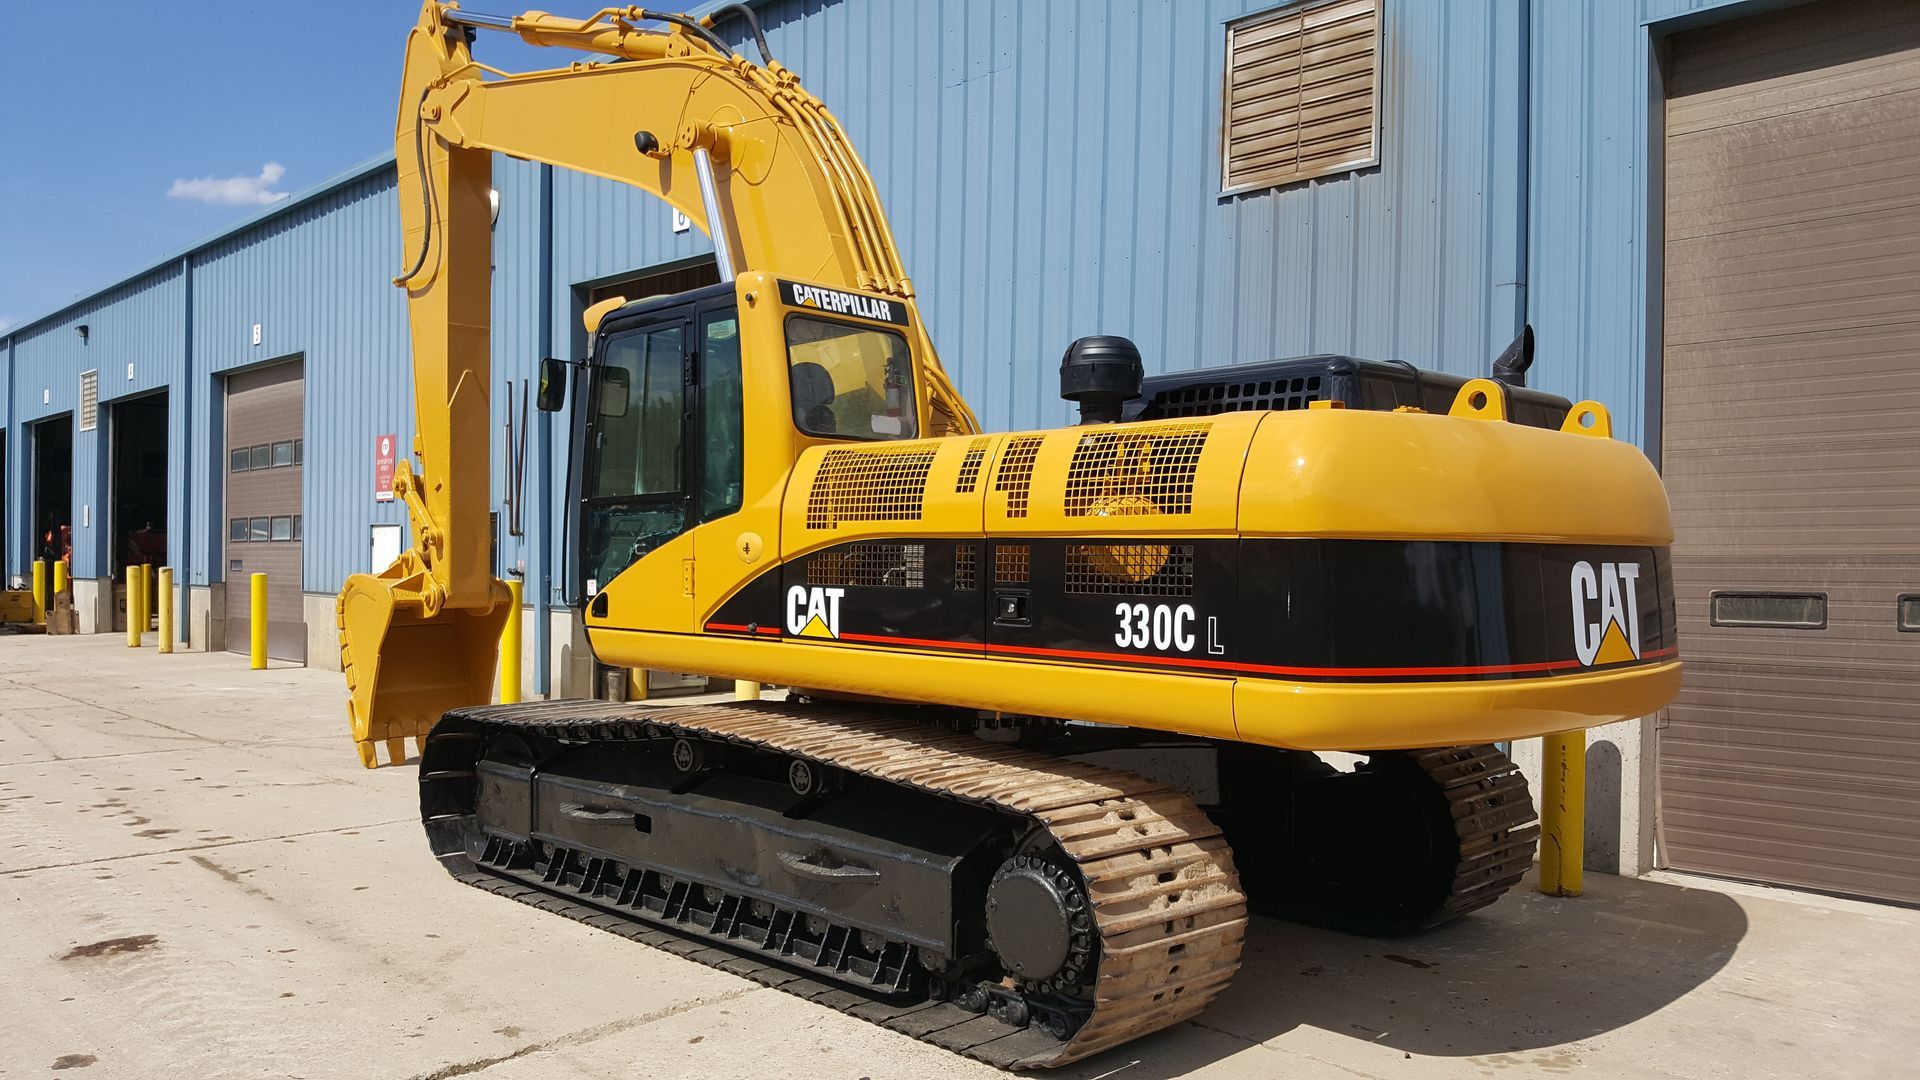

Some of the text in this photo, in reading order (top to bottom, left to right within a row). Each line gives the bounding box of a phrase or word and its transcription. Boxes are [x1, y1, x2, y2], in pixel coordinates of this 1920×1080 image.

[792, 284, 892, 322] CATERPILLAR
[786, 585, 845, 639] CAT
[1115, 602, 1224, 655] 330C L
[1571, 560, 1640, 667] CAT
